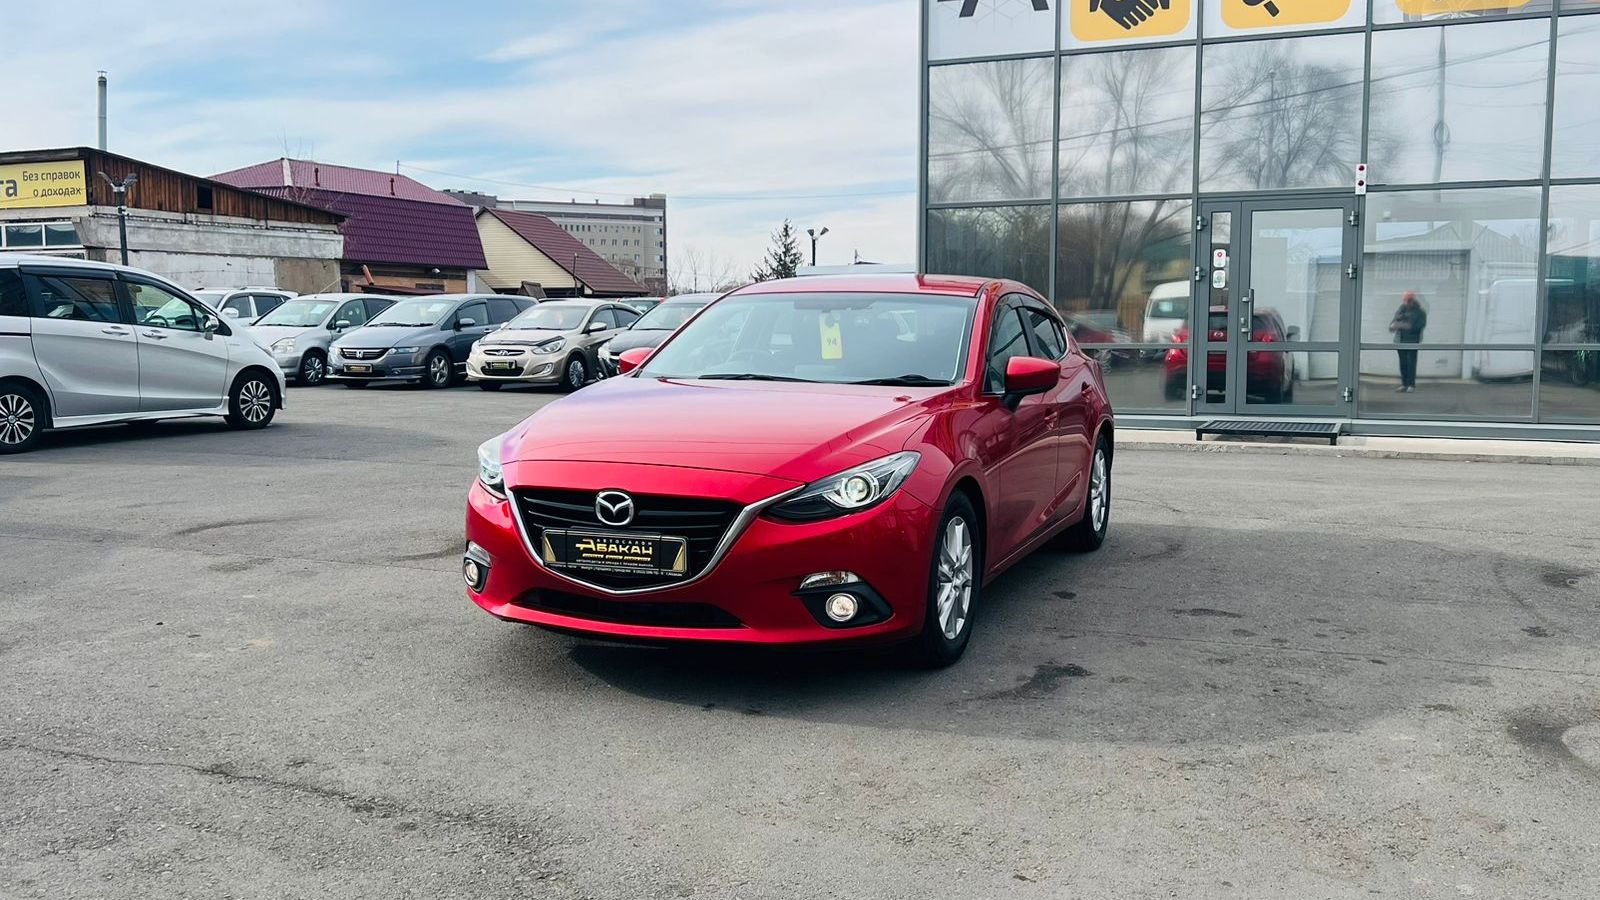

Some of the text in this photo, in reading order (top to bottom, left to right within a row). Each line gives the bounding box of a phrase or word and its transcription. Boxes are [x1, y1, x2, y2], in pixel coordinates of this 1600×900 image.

[22, 171, 81, 182] Без справок
[0, 179, 17, 197] а
[33, 187, 81, 197] о доходах
[576, 539, 653, 555] АБАКАН
